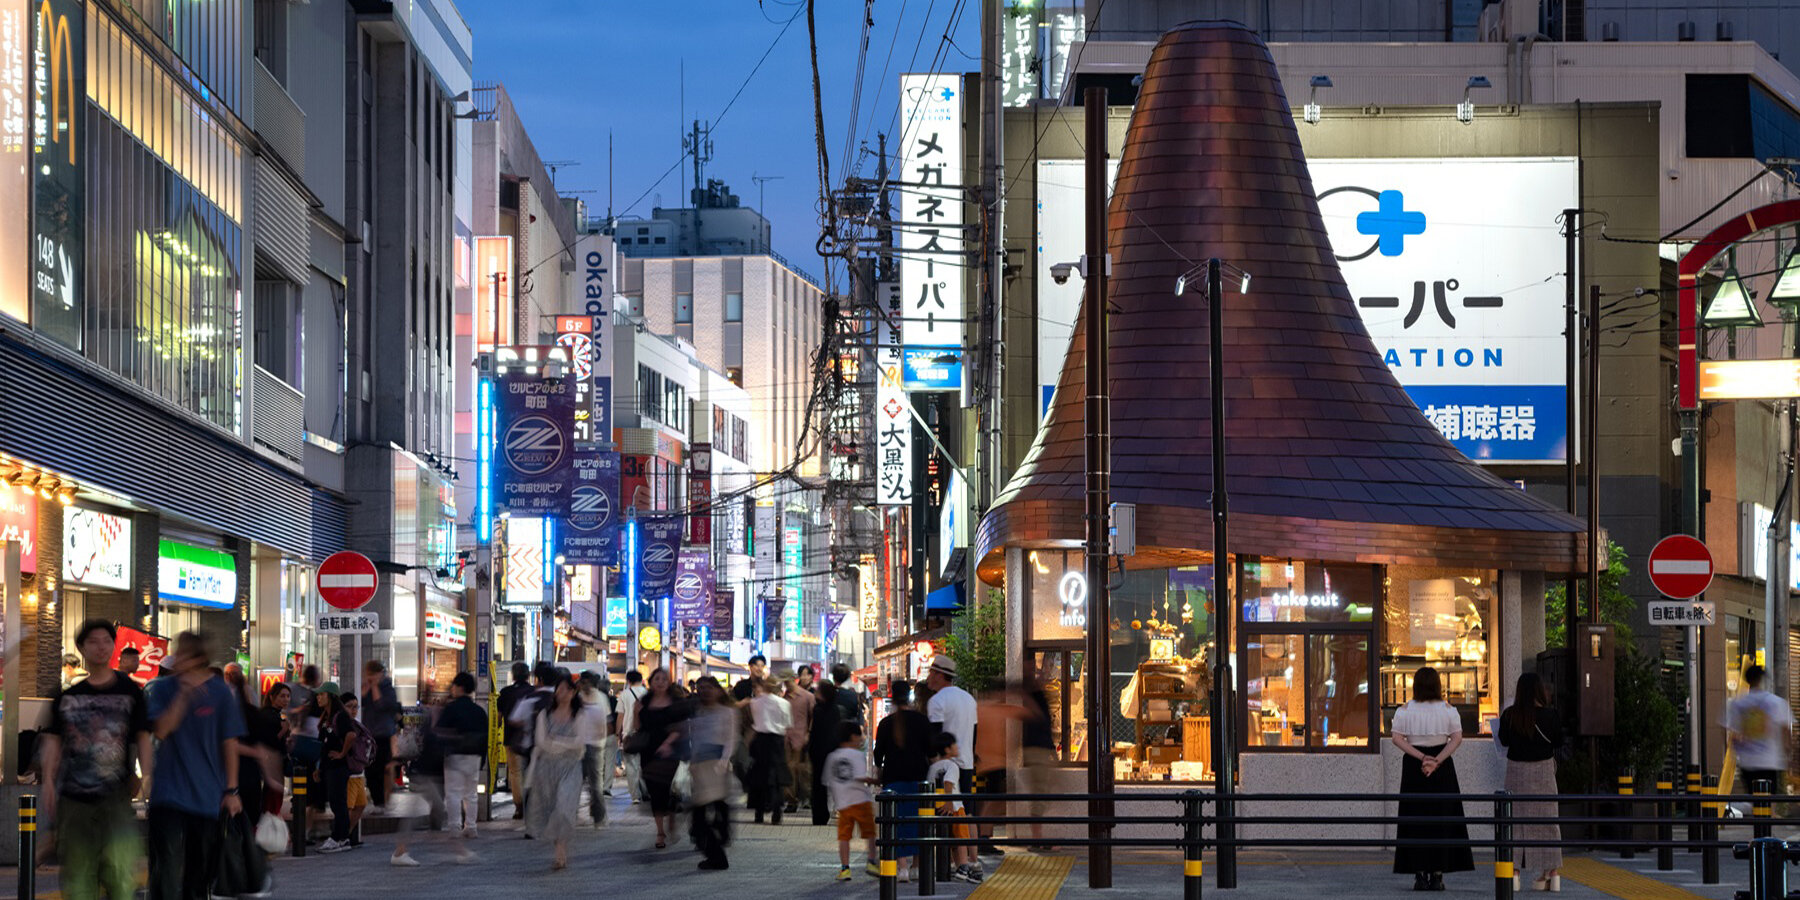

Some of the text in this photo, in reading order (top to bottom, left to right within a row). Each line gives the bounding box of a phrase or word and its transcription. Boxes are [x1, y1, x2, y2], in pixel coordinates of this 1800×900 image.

[917, 132, 947, 332] メガネスーパー
[37, 233, 54, 269] 148
[37, 271, 54, 296] SEATS
[564, 318, 583, 332] 5F
[525, 395, 548, 409] 町田
[1424, 404, 1537, 441] 補聴器
[625, 456, 644, 478] 3F
[880, 423, 912, 502] 大黒さん
[579, 469, 597, 480] 町田
[188, 569, 222, 595] FamilyMart
[1272, 590, 1339, 607] take out
[319, 616, 376, 631] 自転車を除く
[1059, 608, 1086, 627] info
[1652, 606, 1712, 621] 自転車を除く
